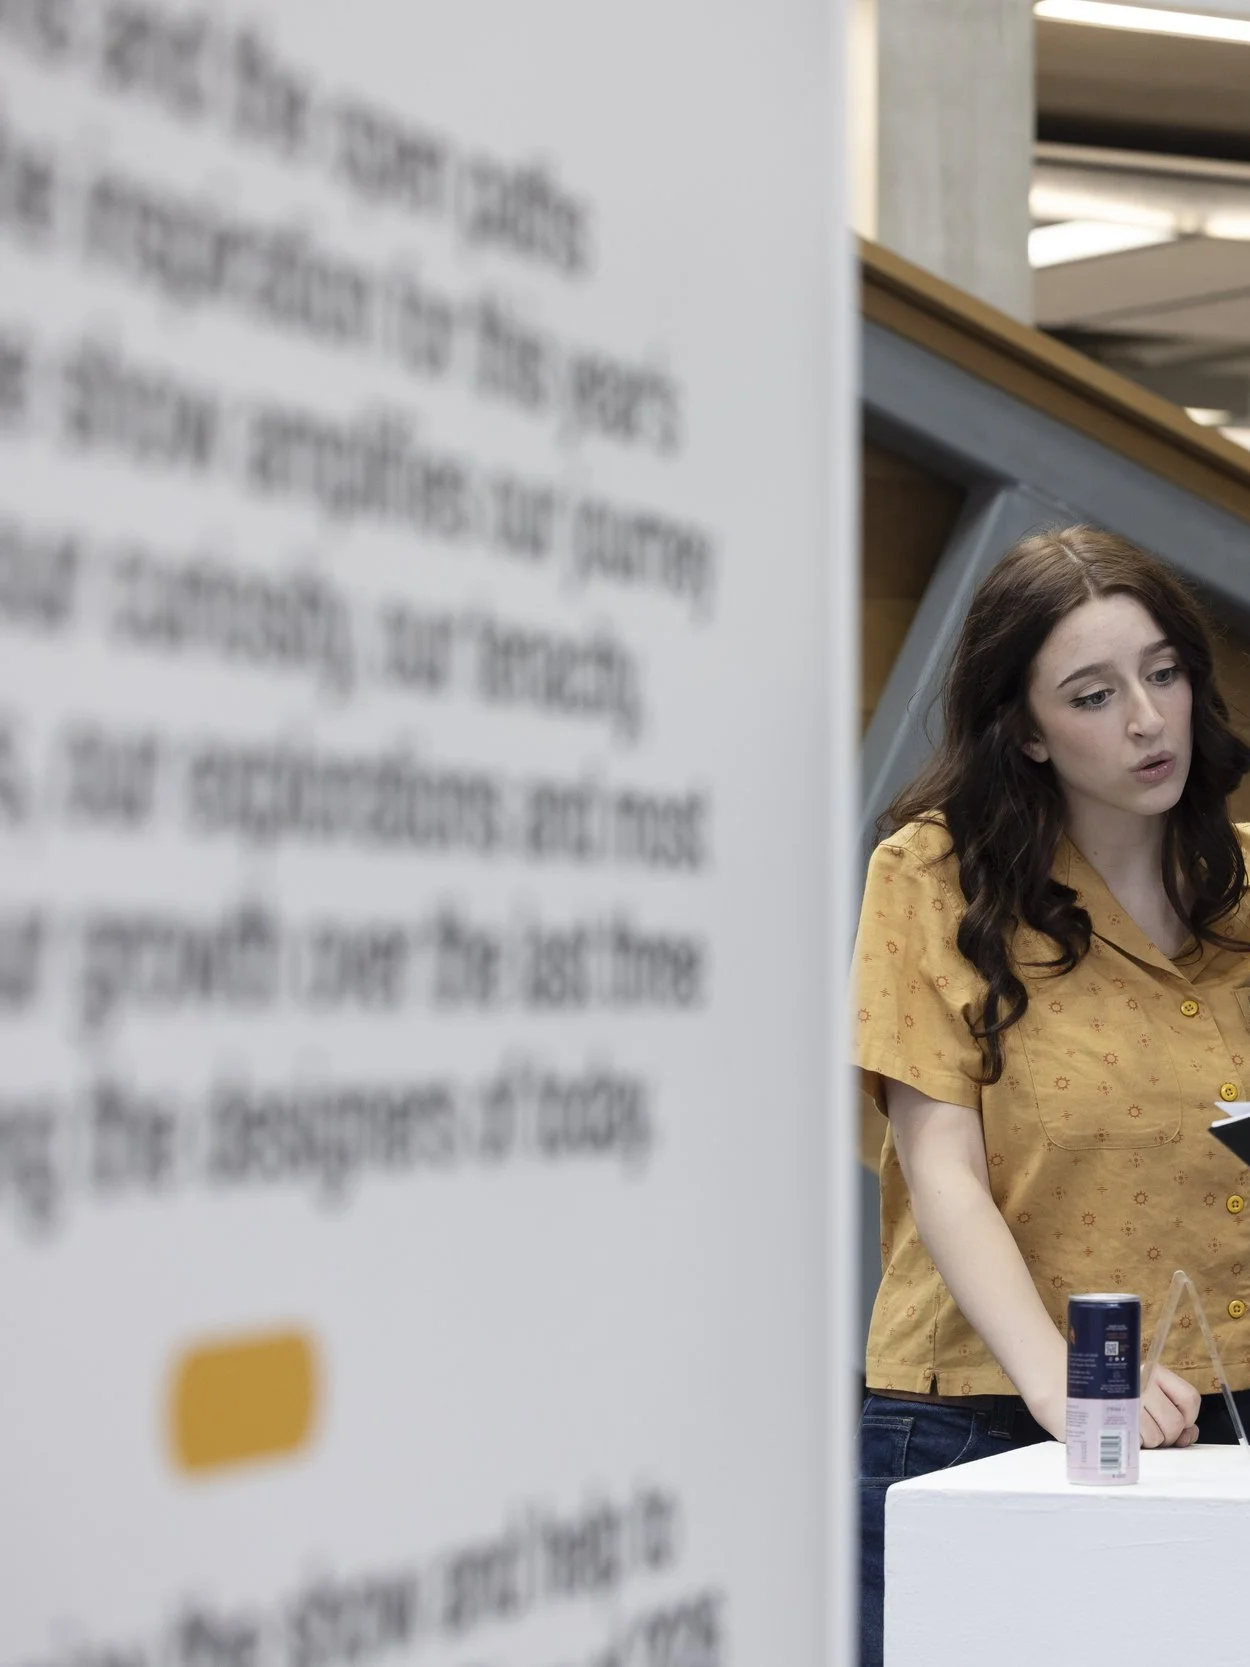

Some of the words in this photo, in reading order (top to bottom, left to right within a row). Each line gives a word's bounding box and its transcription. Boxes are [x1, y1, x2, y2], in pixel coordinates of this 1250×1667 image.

[225, 15, 312, 165] the
[327, 95, 452, 205] open
[78, 130, 378, 355] inspiration
[397, 255, 462, 380] for
[470, 285, 553, 415] this
[57, 325, 225, 478] show
[240, 400, 475, 545] amplifies
[488, 470, 558, 562] our
[570, 468, 716, 615] journey
[378, 598, 462, 692] our
[58, 722, 168, 828] our
[178, 720, 507, 868] explorations
[520, 765, 600, 865] and
[608, 782, 710, 875] most
[68, 890, 288, 1045] growth
[300, 918, 418, 1010] over
[428, 895, 505, 1008] the
[517, 895, 600, 1012] last
[606, 900, 708, 1012] three
[82, 1065, 180, 1200] the
[200, 1065, 460, 1208] designers
[474, 1050, 526, 1165] of
[278, 1555, 420, 1667] show
[435, 1500, 525, 1640] and
[535, 1480, 628, 1608] help
[638, 1475, 678, 1575] to
